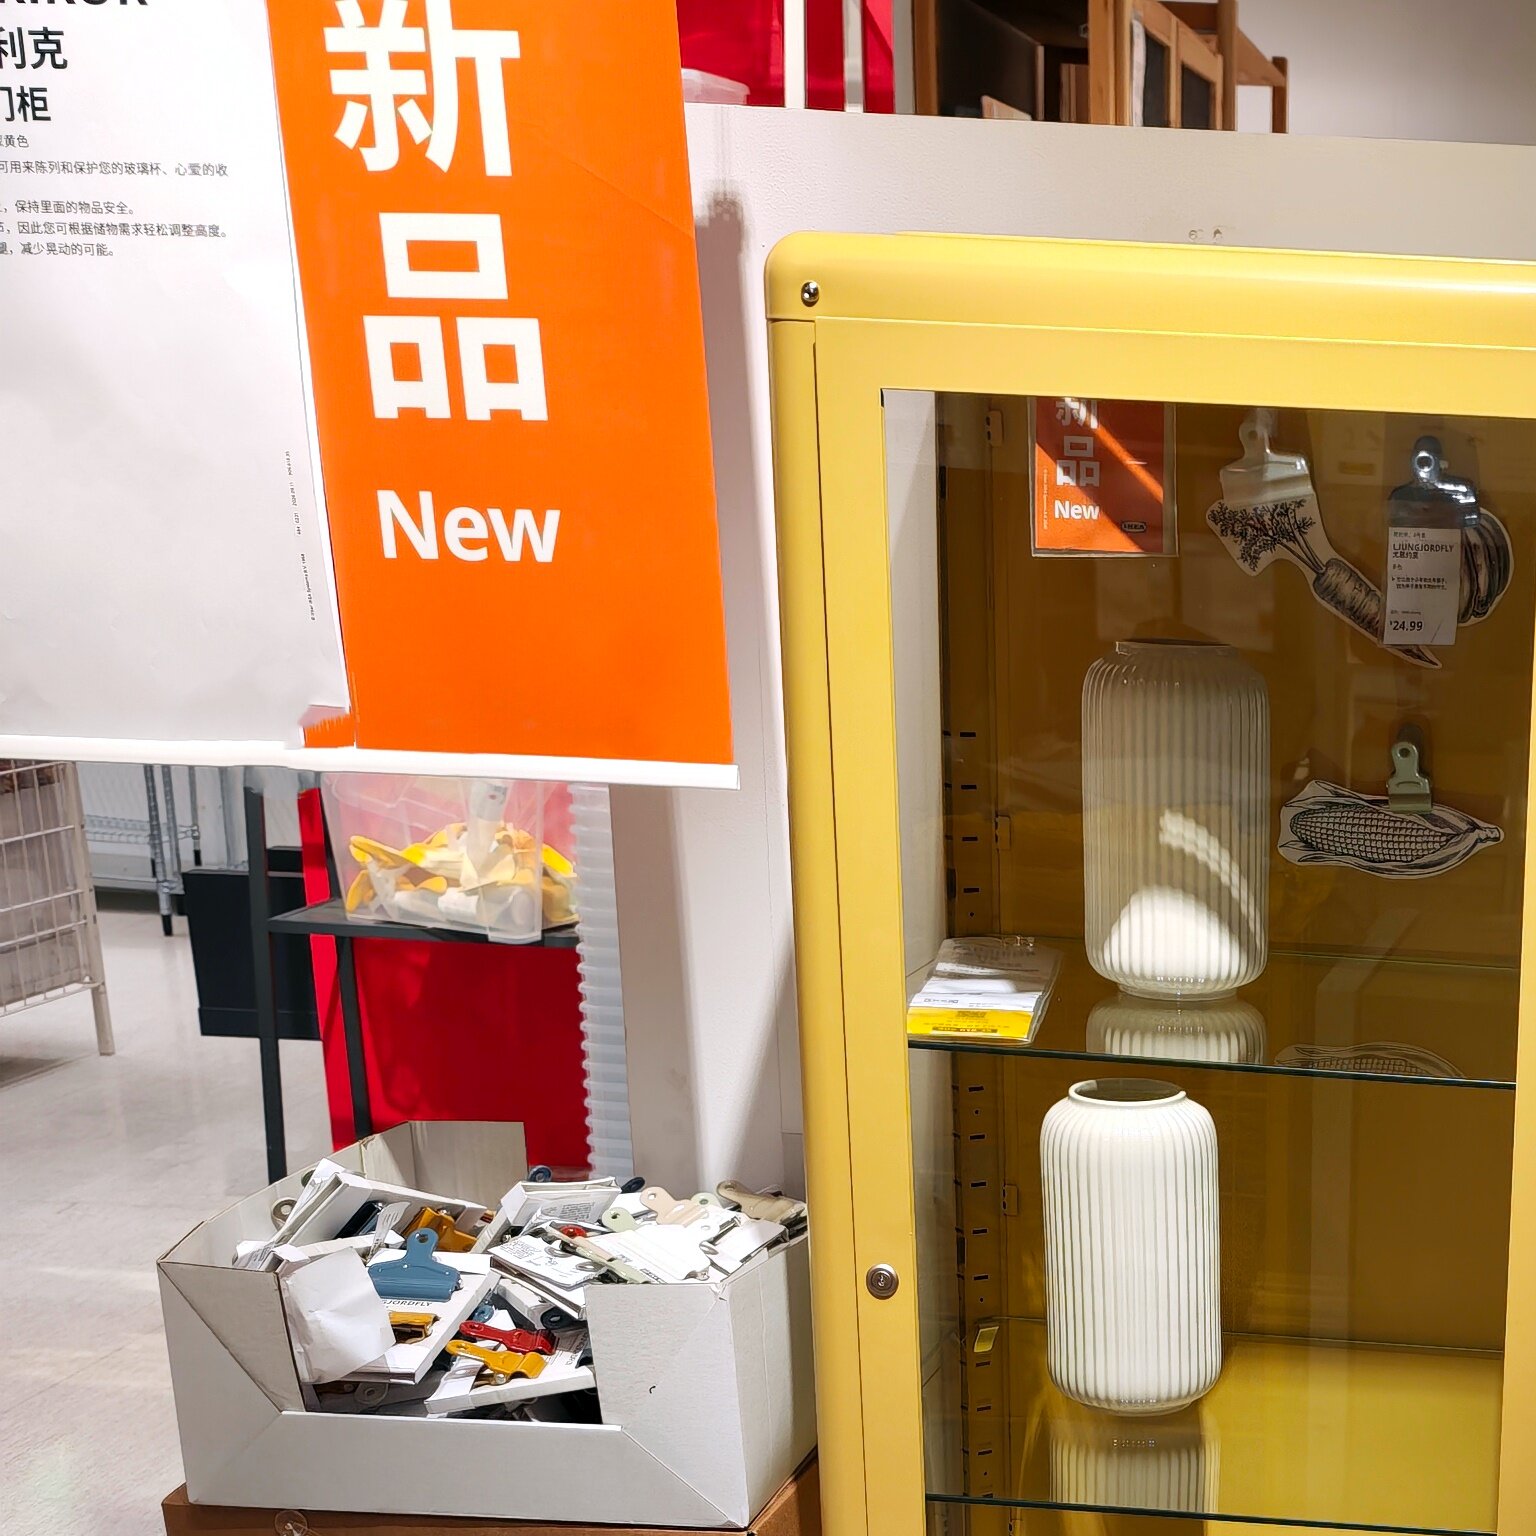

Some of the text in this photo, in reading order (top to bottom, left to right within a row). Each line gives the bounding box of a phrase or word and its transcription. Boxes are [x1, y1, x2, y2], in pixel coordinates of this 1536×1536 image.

[0, 27, 68, 69] 利克
[324, 0, 548, 421] 新品
[1054, 500, 1100, 520] New
[377, 490, 561, 562] New
[1122, 522, 1146, 532] IKEA
[1393, 543, 1455, 553] LJUNGJORDFLY
